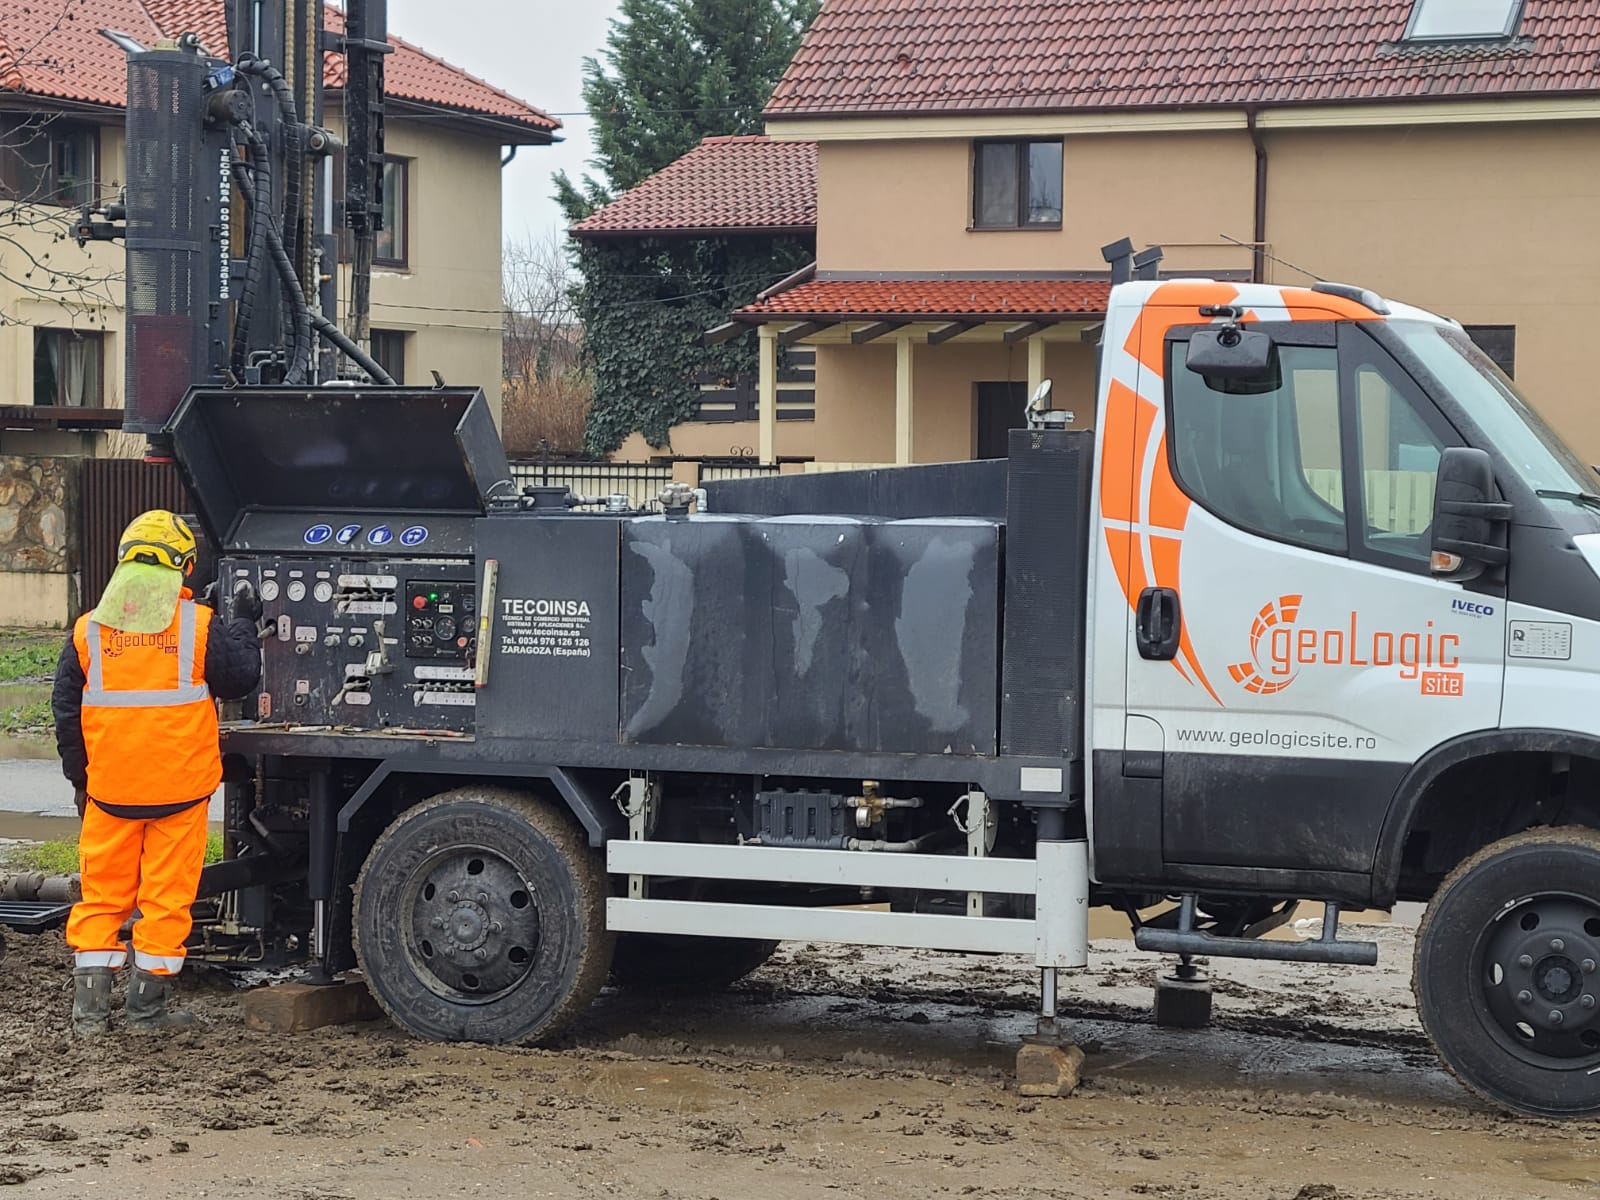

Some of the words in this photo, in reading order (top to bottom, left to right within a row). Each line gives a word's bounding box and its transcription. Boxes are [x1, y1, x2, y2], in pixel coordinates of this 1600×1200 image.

[219, 148, 230, 203] TECOINSA
[502, 600, 591, 616] TECOINSA
[1451, 599, 1494, 616] IVECO
[512, 628, 580, 636] www.tecoinsa.es
[501, 636, 517, 645] Tel.
[518, 637, 539, 645] 0034
[540, 637, 556, 646] 976
[557, 638, 573, 647] 126
[574, 638, 590, 647] 126
[501, 646, 552, 655] ZARAGOZA
[553, 648, 591, 658] (España)
[1426, 673, 1460, 694] site
